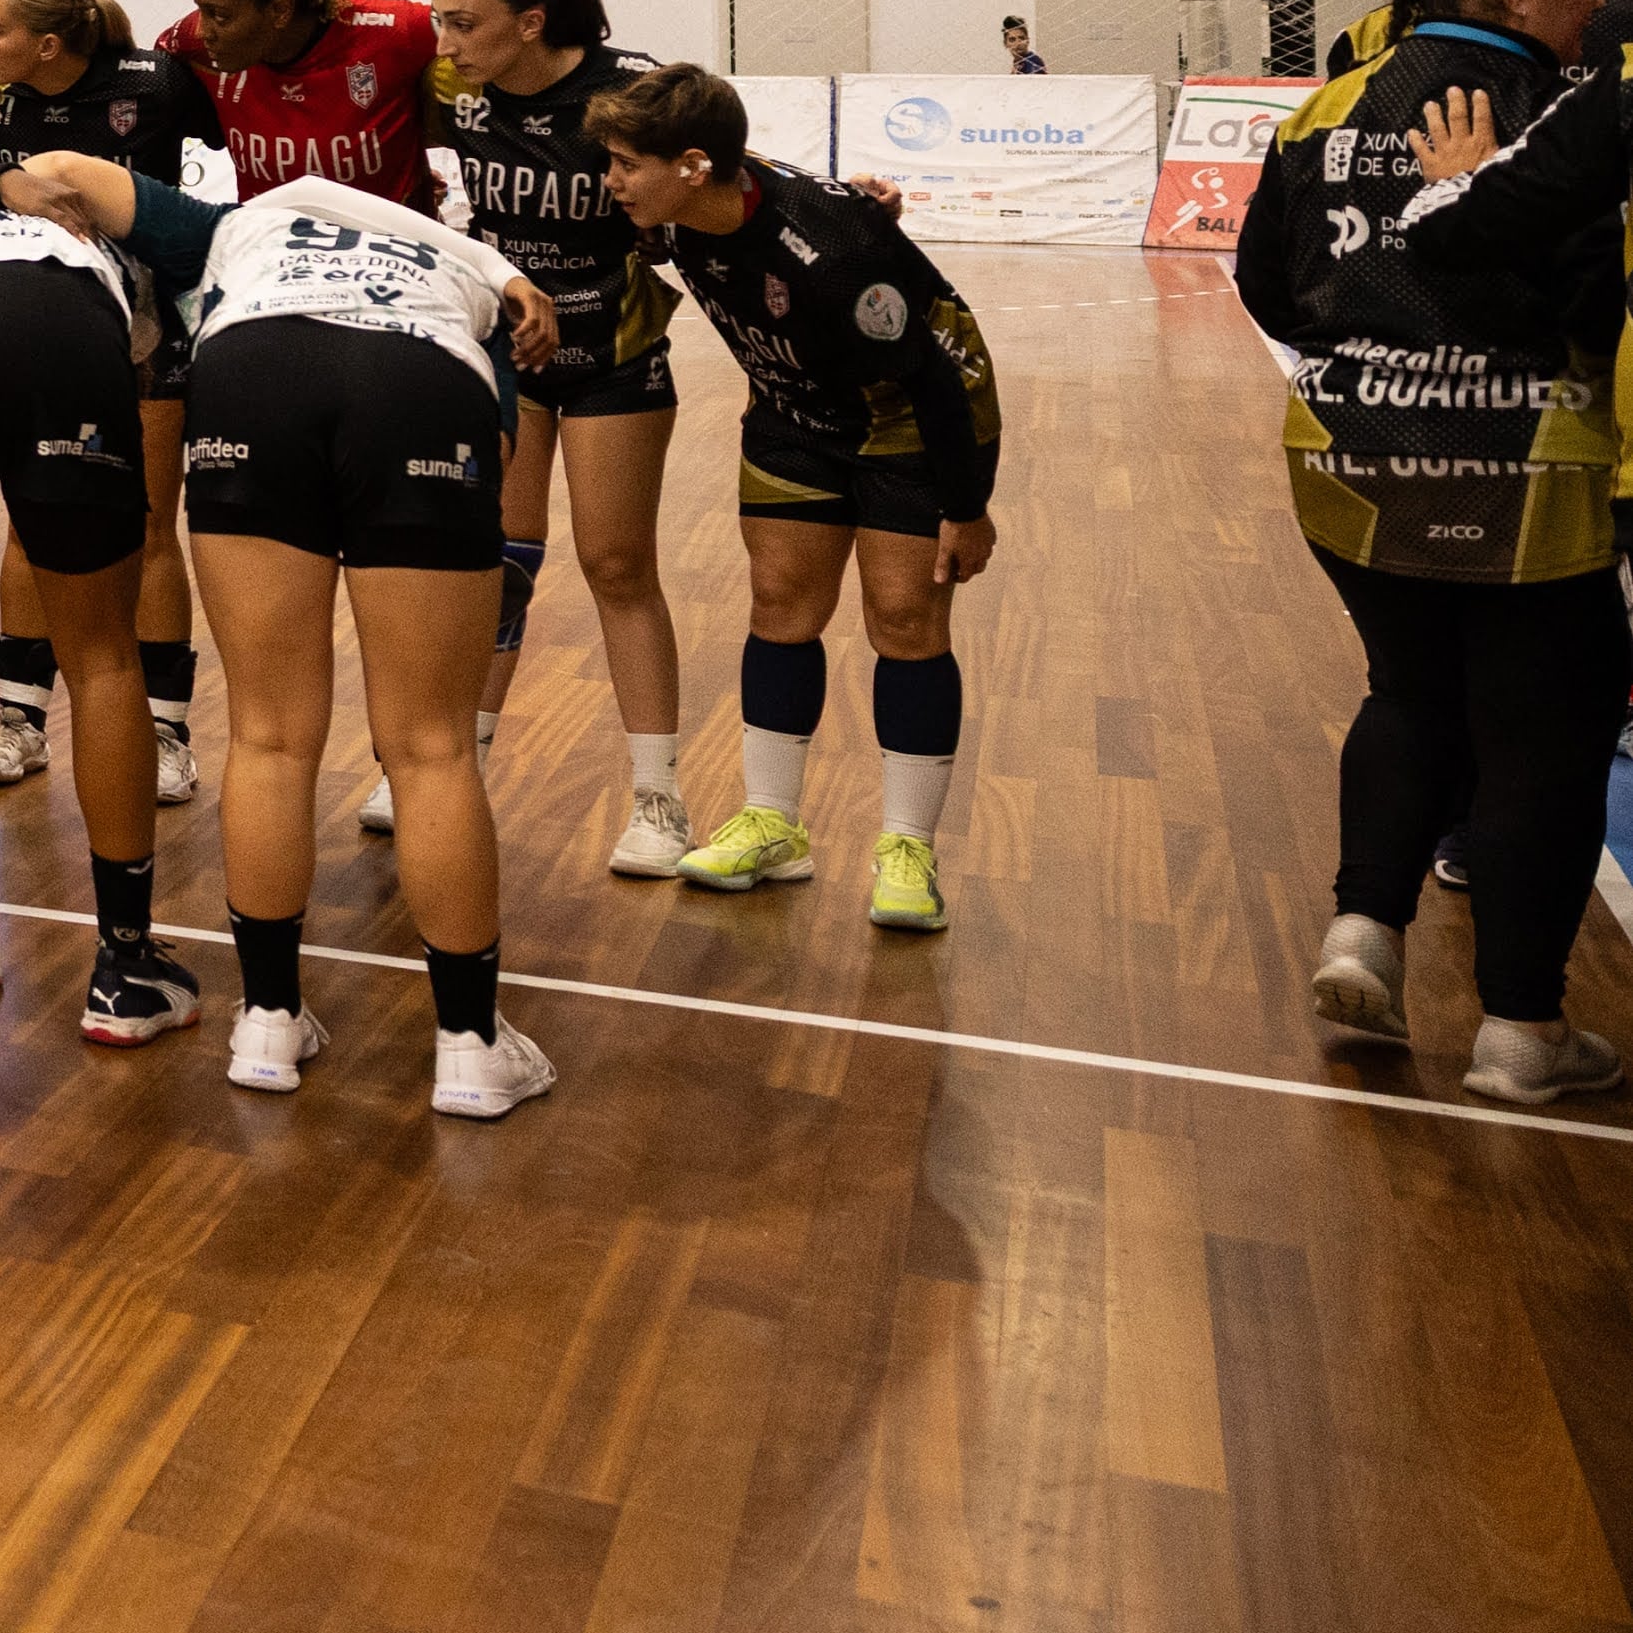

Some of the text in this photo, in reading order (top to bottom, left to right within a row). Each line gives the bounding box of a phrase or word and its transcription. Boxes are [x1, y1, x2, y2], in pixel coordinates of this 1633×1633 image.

[454, 93, 491, 133] 92
[959, 122, 1086, 146] sunoba
[229, 127, 383, 186] ORPAGU
[1357, 156, 1386, 176] DE
[503, 238, 562, 255] XUNTA
[504, 253, 598, 270] DE GALICIA
[1334, 335, 1489, 377] Mecalia
[37, 438, 84, 457] suma
[189, 436, 250, 460] affidea
[407, 457, 465, 480] suma
[1427, 524, 1486, 541] ZICO
